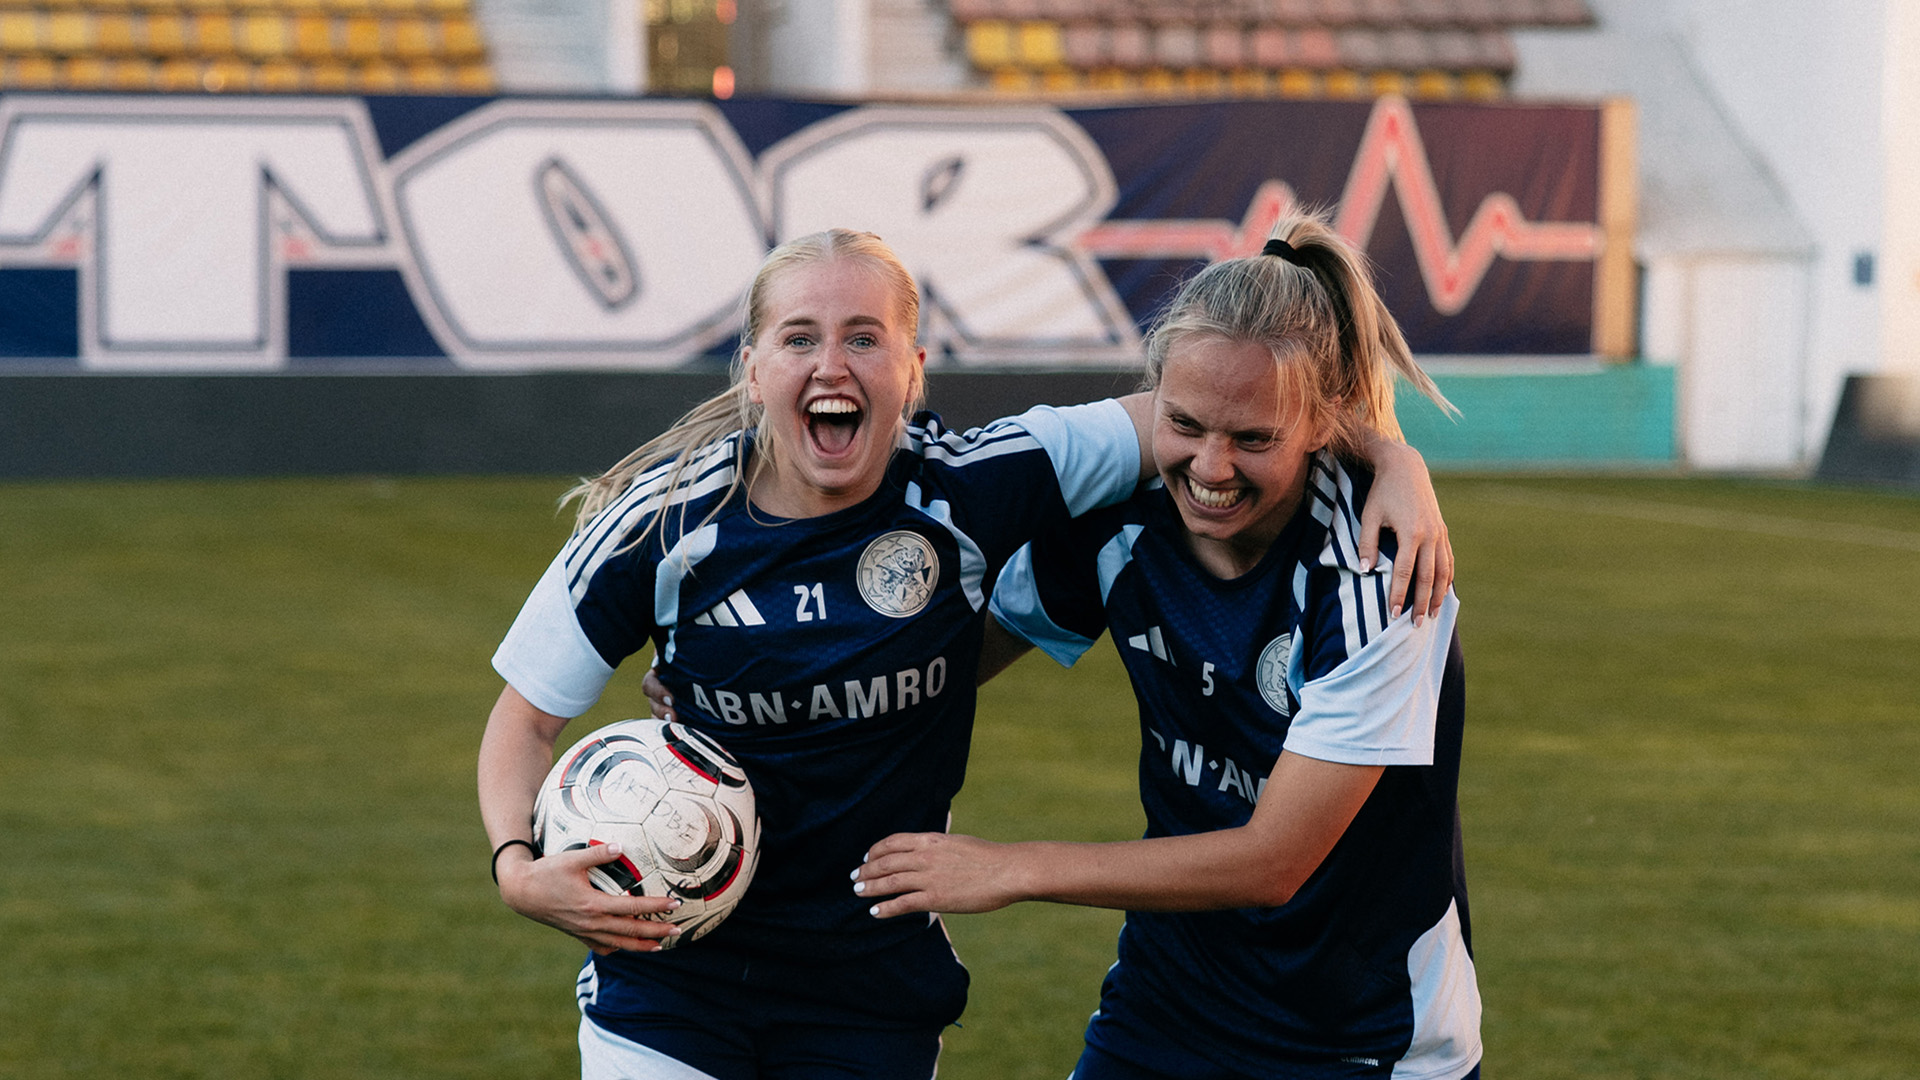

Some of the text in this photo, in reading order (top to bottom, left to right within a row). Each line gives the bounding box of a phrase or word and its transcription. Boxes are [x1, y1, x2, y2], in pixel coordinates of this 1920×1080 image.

[0, 97, 1145, 369] TOR
[794, 582, 827, 622] 21
[1202, 661, 1215, 697] 5
